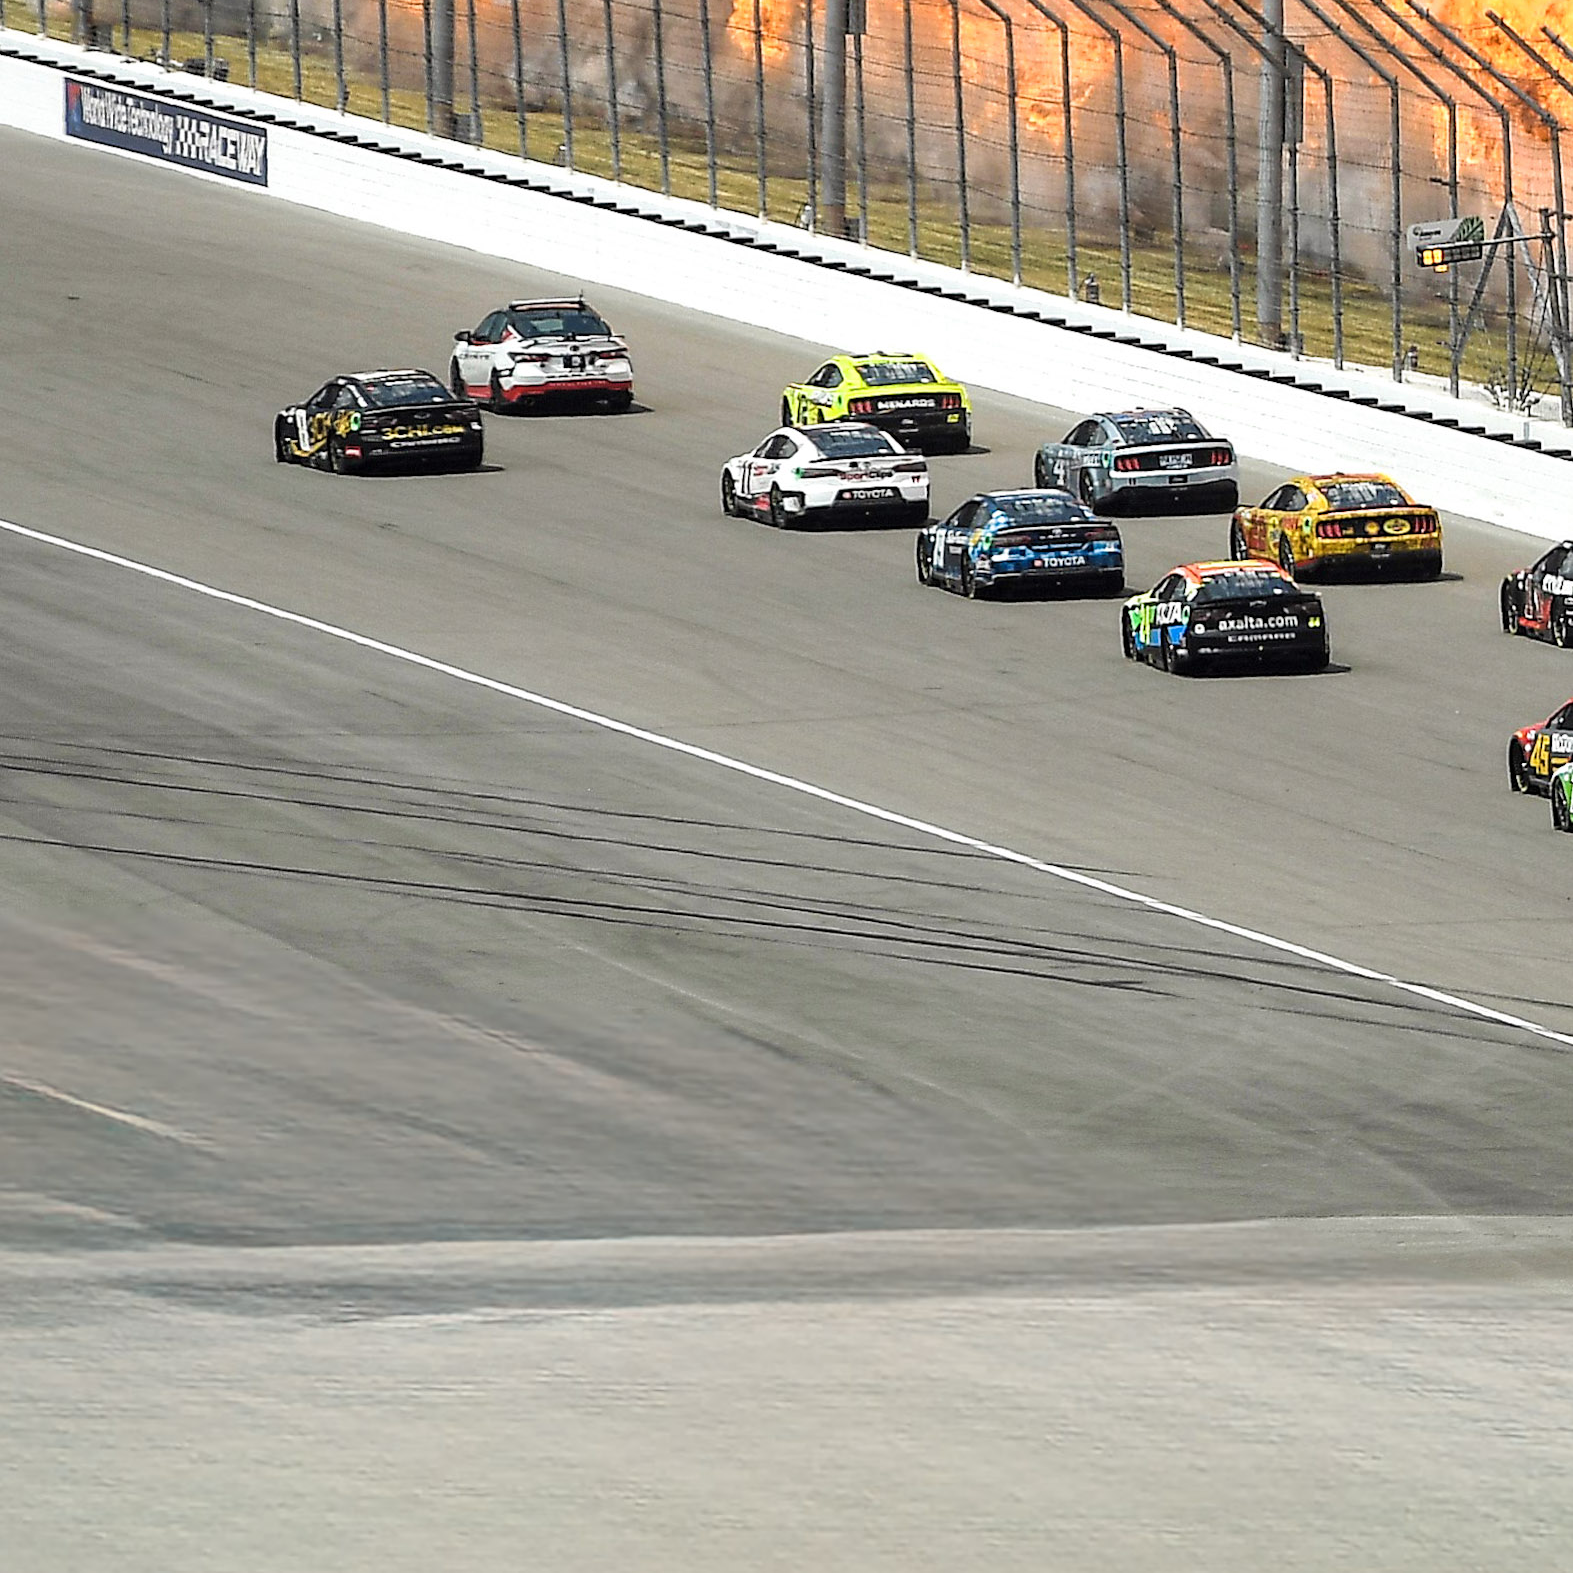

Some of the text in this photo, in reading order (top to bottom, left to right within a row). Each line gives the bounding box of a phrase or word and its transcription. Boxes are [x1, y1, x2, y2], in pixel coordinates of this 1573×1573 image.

[199, 121, 266, 177] RACEWAY
[877, 398, 936, 411] MENARDS
[852, 488, 895, 500] TOYOTA
[1043, 555, 1087, 569] TOYOTA
[1218, 615, 1299, 632] axalta.com
[1530, 732, 1550, 776] 45
